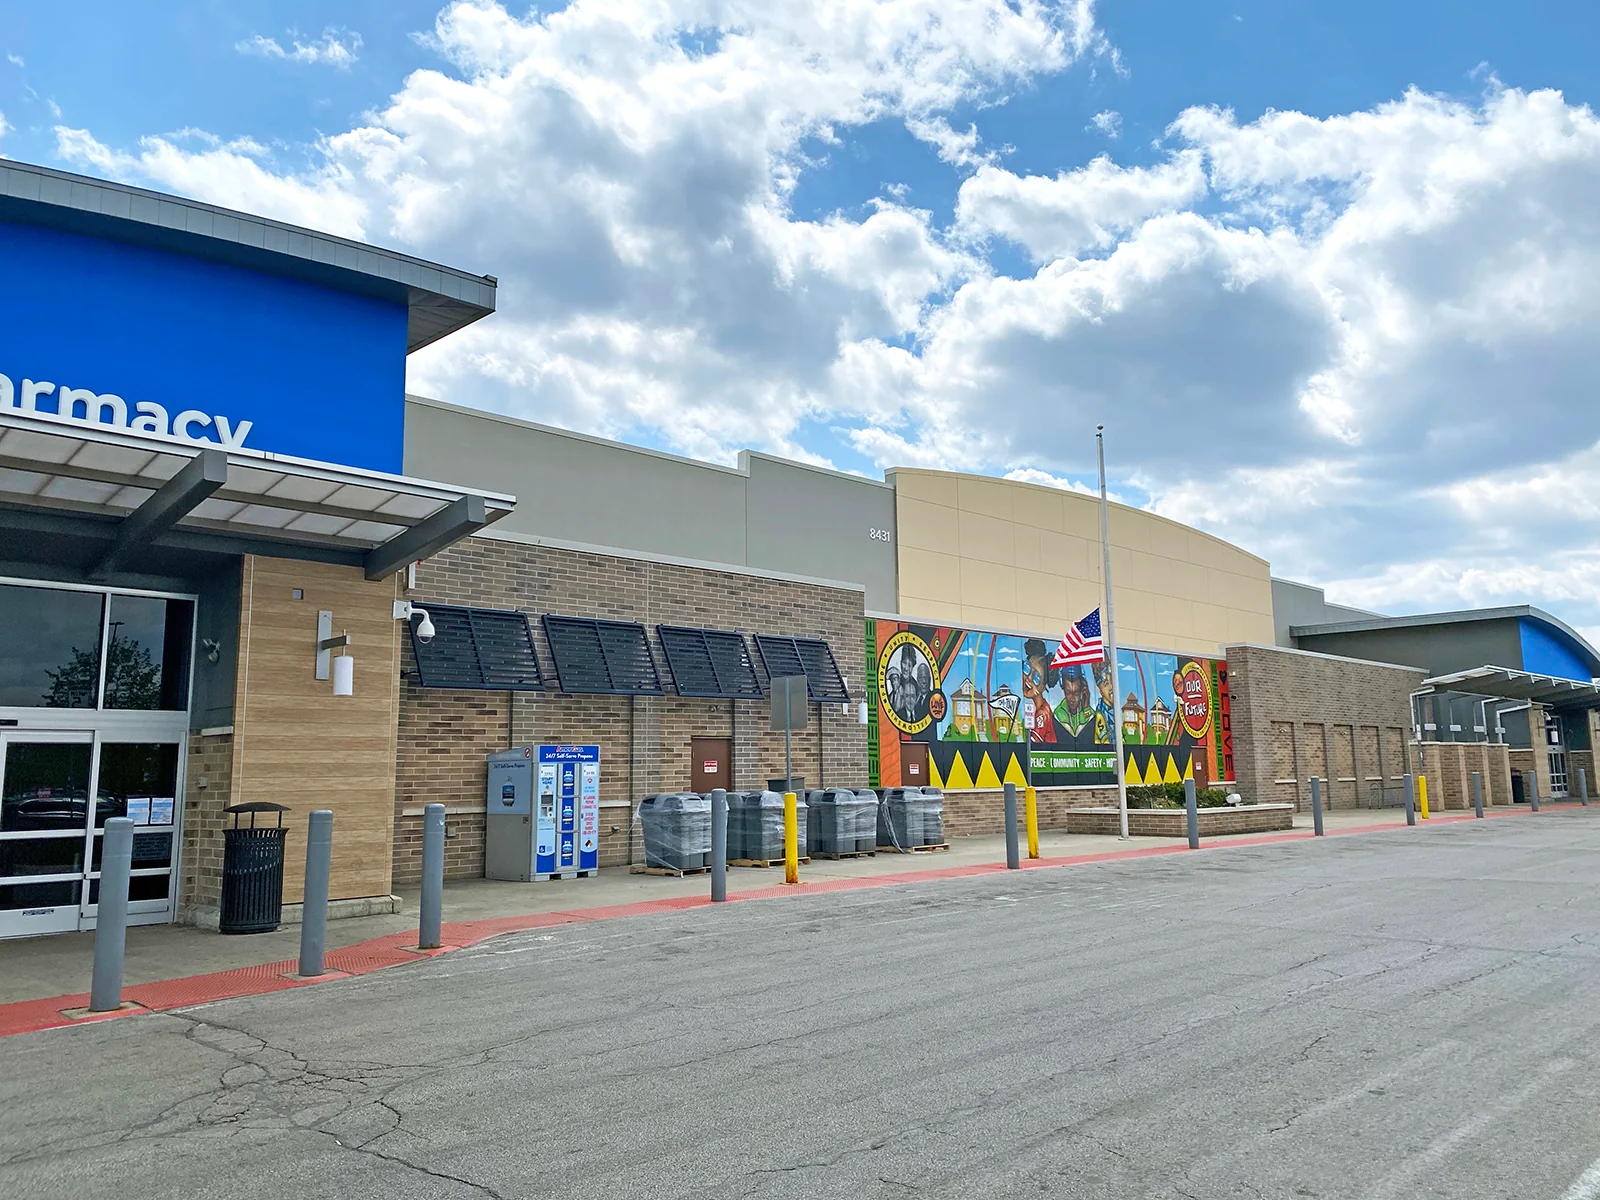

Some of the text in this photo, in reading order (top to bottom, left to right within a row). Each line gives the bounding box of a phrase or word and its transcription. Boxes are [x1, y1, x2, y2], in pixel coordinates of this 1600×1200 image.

[869, 527, 891, 542] 8431
[888, 635, 909, 650] UNITY
[918, 641, 939, 681] RESPECT
[1185, 679, 1203, 693] OUR
[1184, 702, 1207, 717] FUTURE
[887, 708, 928, 731] FELLOWSHIP
[1221, 693, 1233, 772] LOVE
[1030, 757, 1046, 768] PEACE
[1050, 757, 1080, 768] COMMUNITY
[1084, 757, 1102, 768] SAFETY
